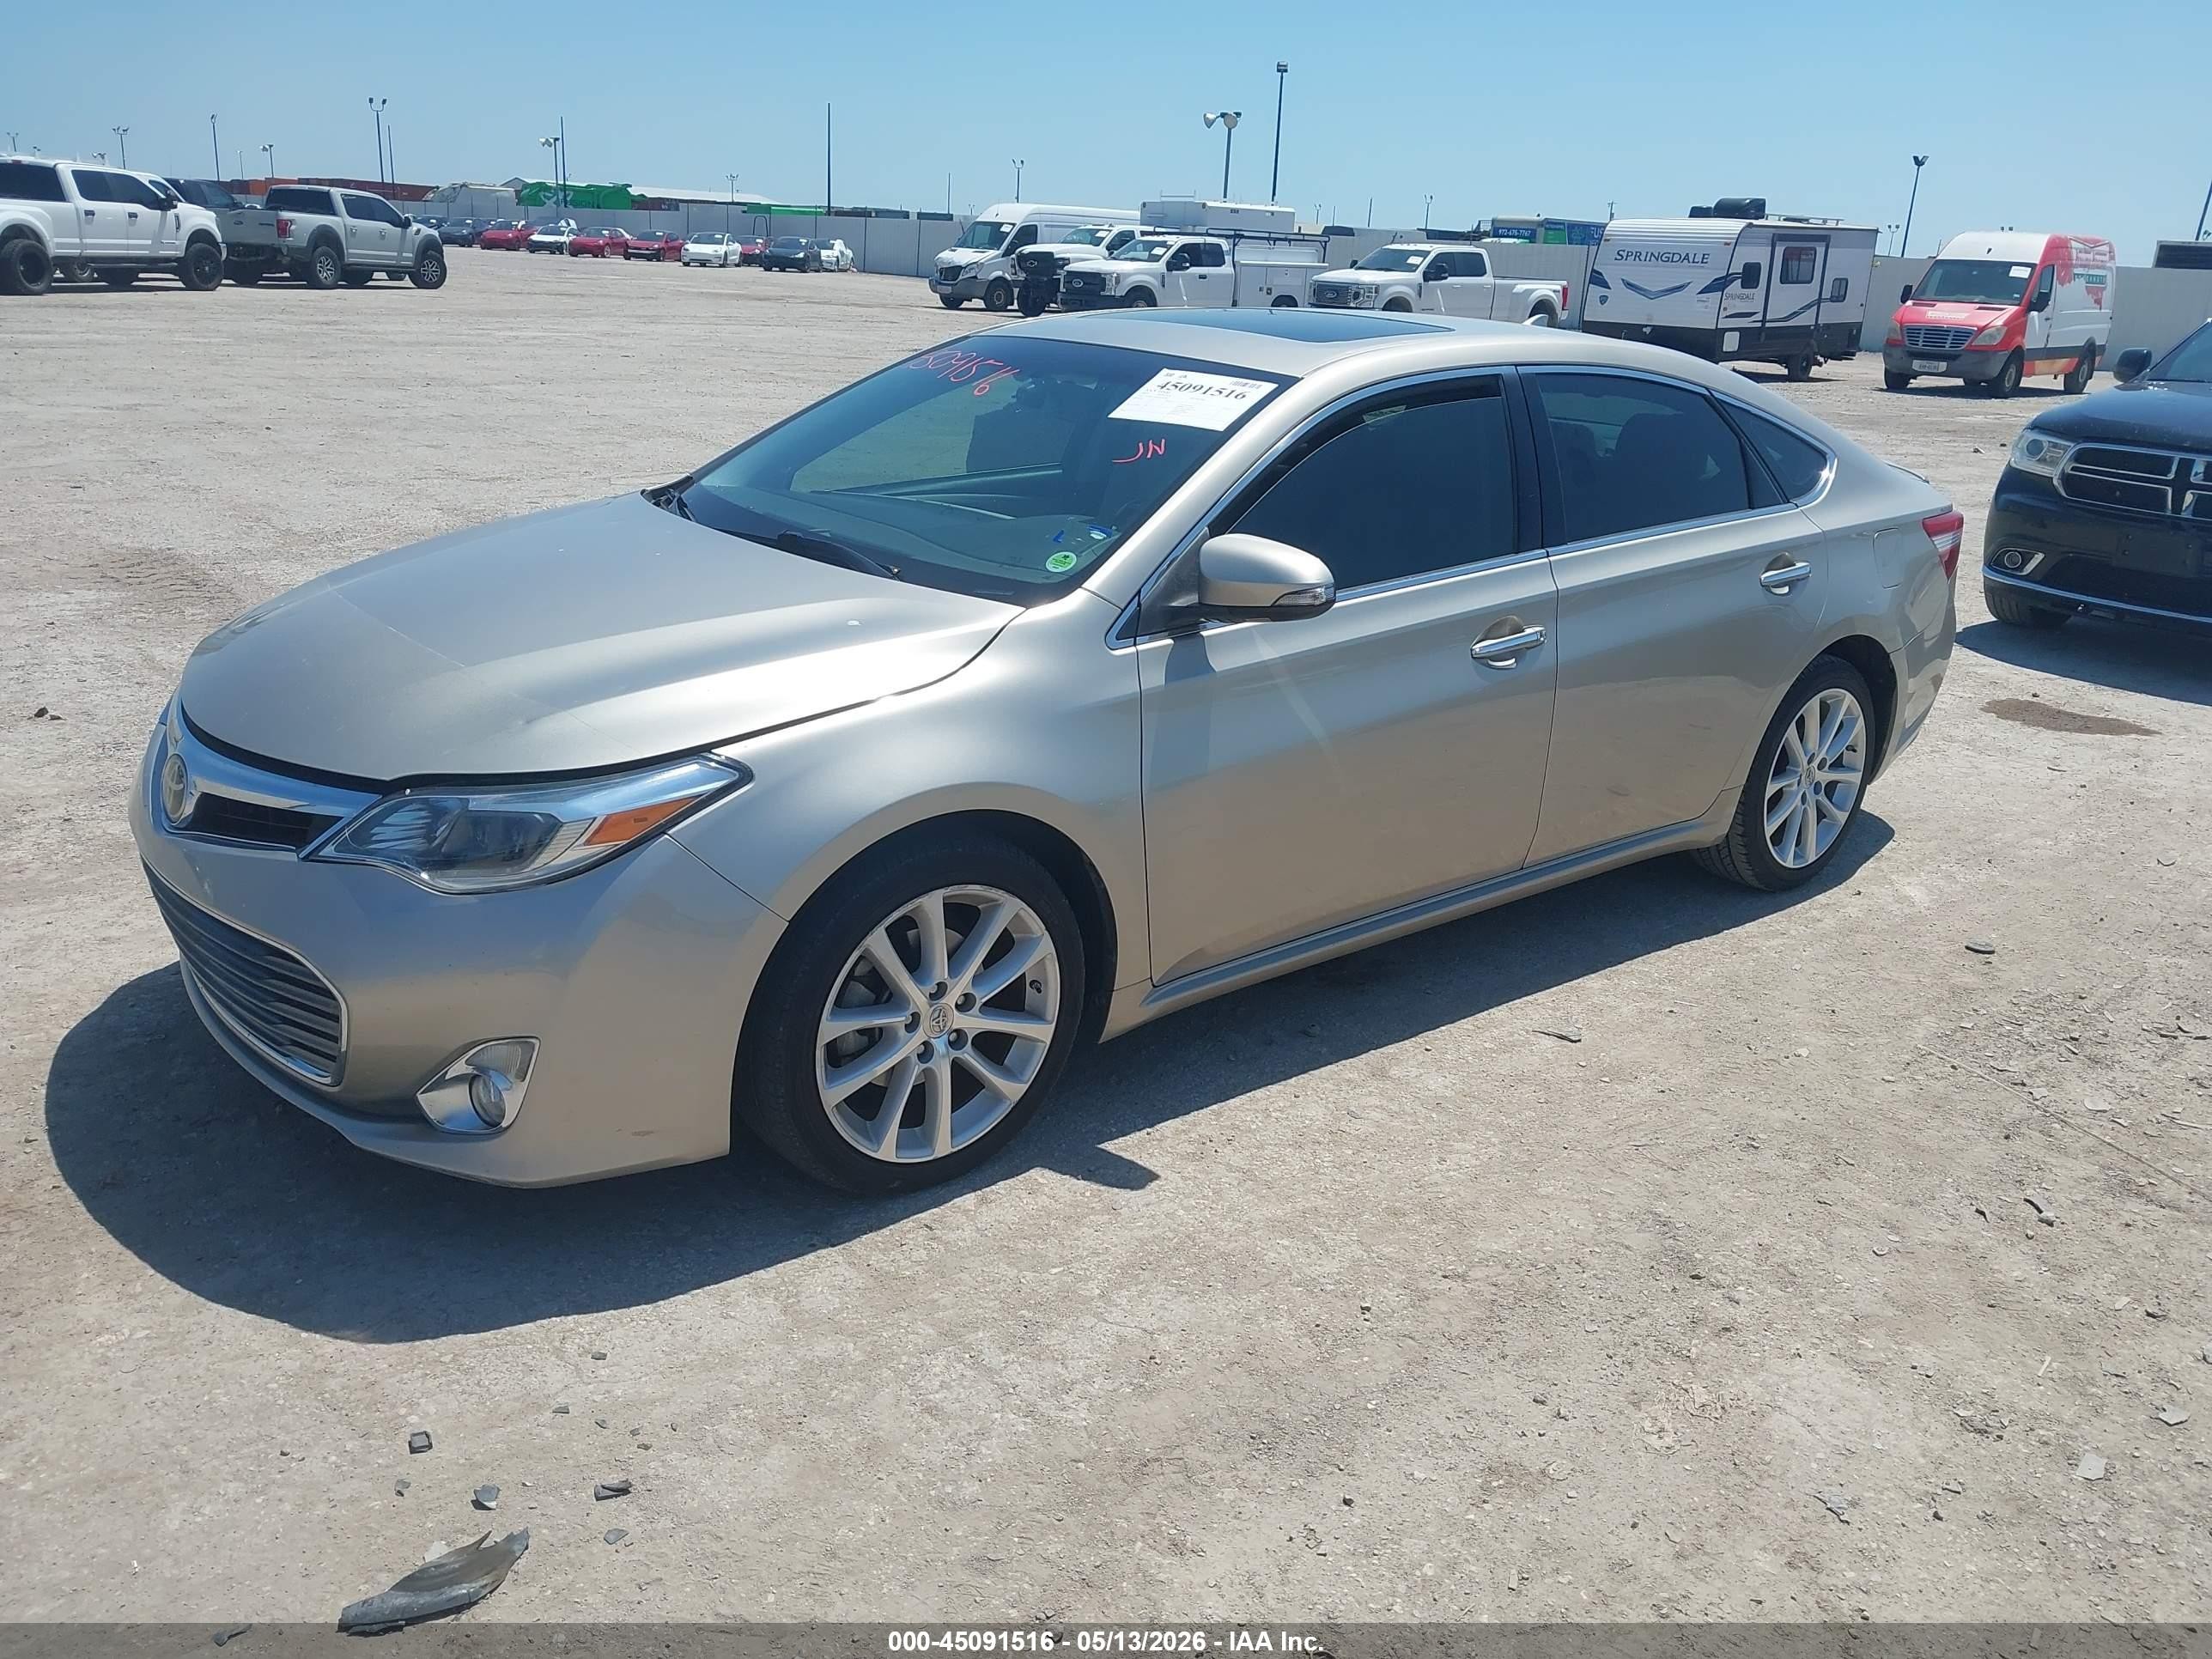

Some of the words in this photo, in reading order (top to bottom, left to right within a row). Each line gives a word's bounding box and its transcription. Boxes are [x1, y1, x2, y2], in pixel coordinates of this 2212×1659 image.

[1614, 249, 1711, 264] SPRINGDALE
[1723, 292, 1756, 301] SPRINGDALE
[1157, 380, 1251, 400] 45091516
